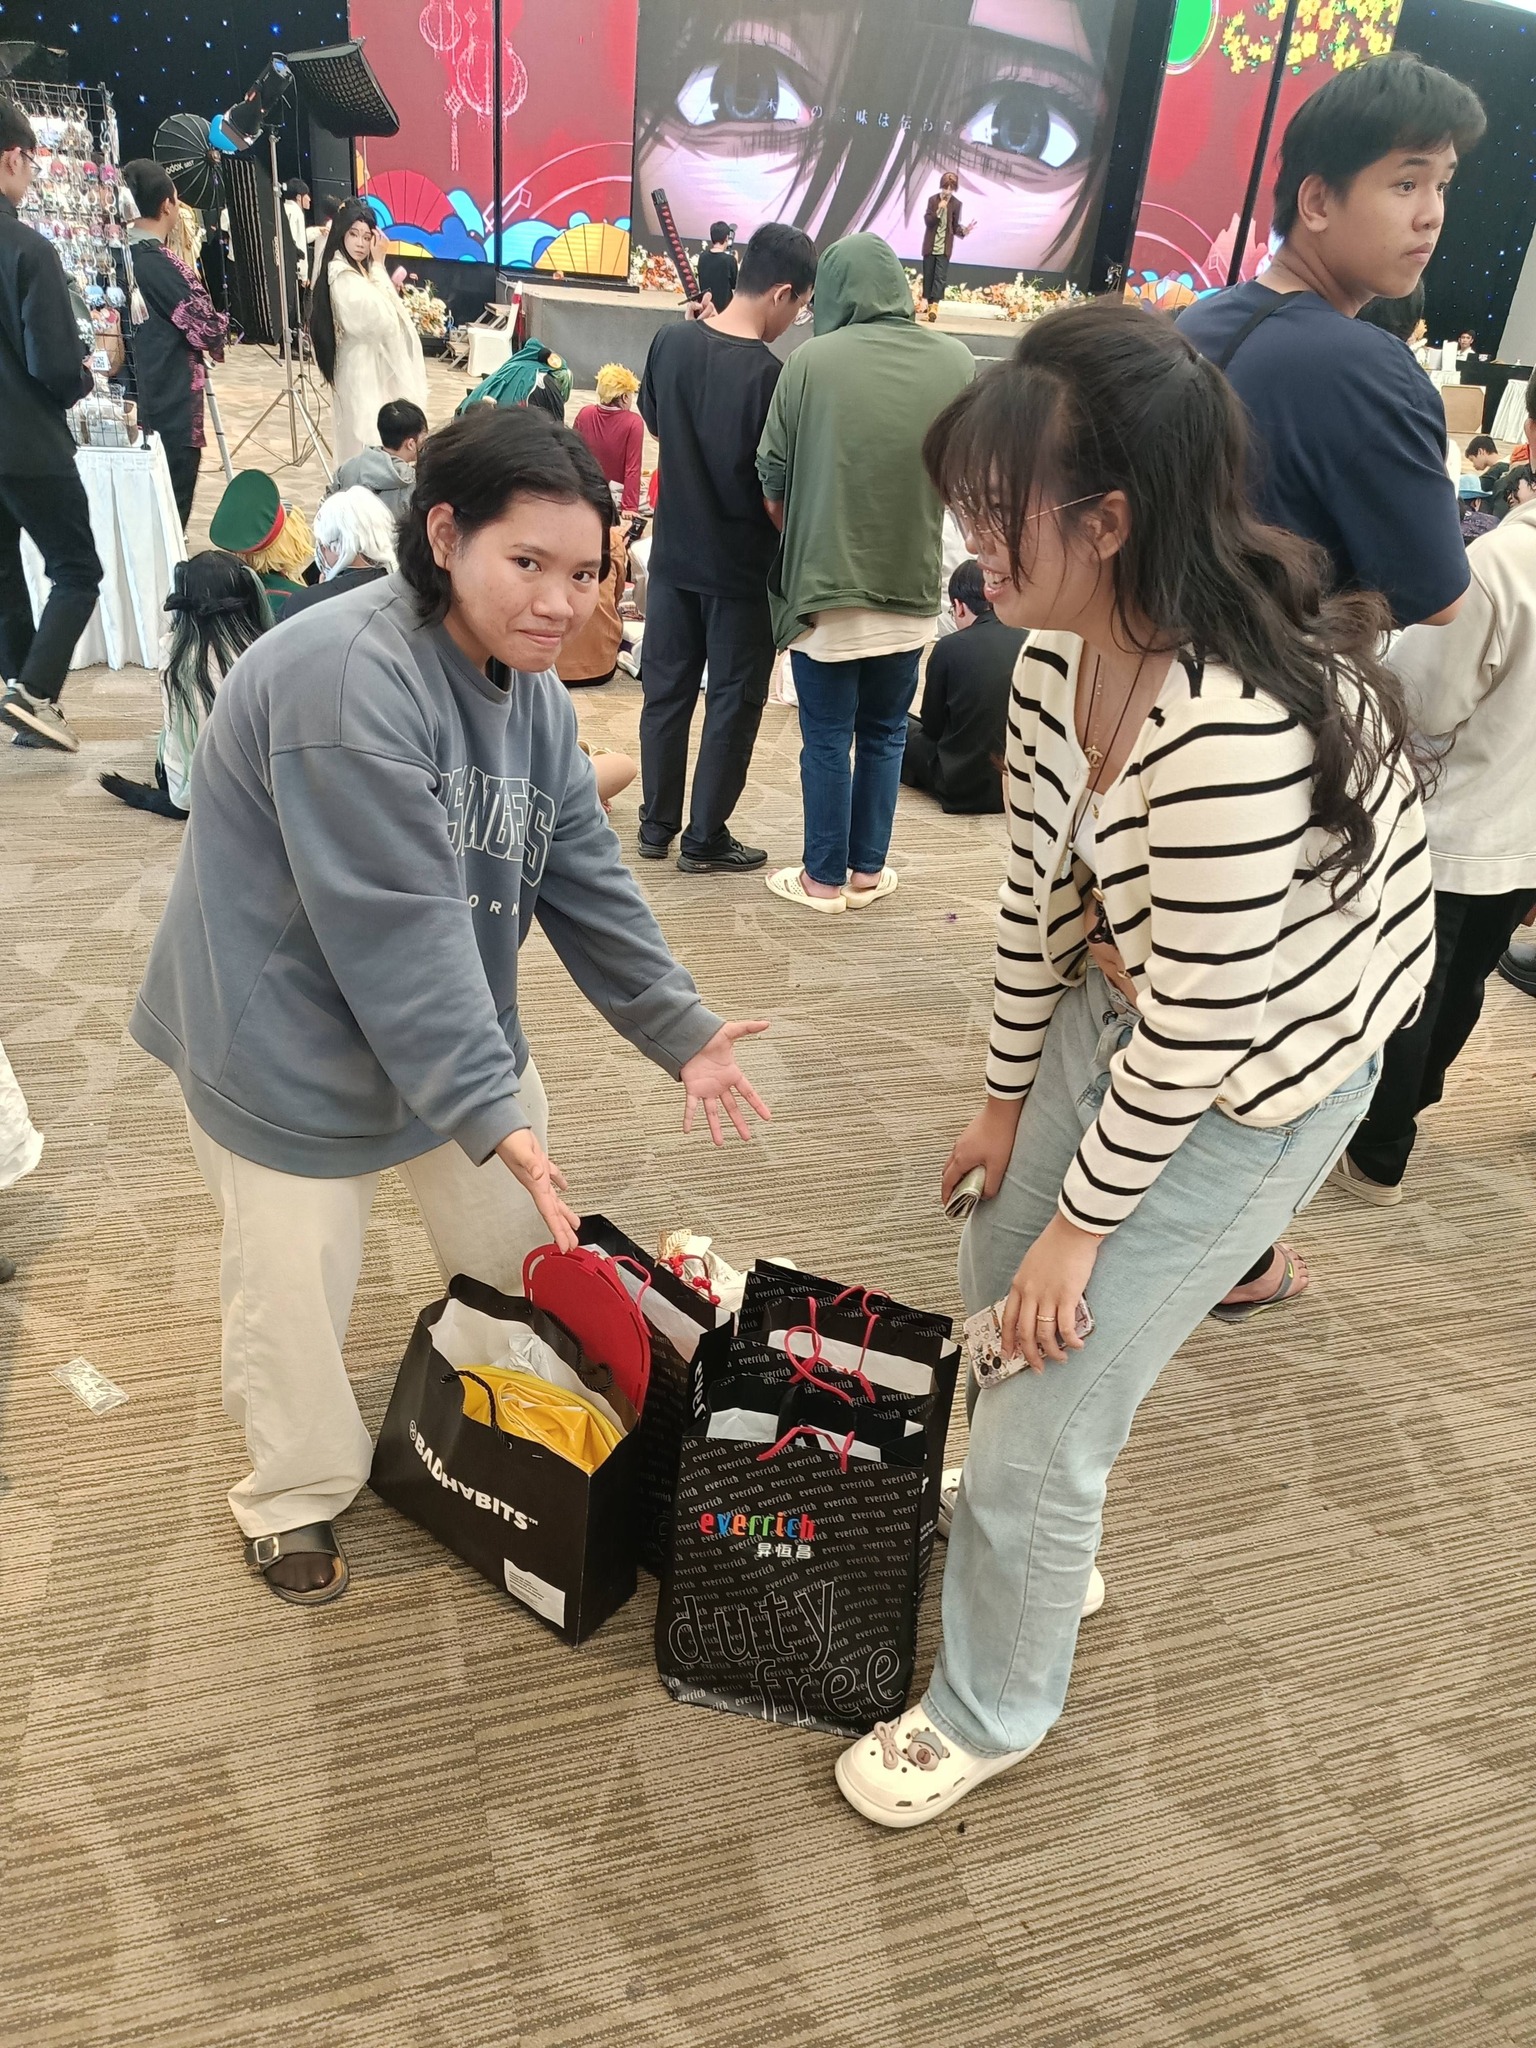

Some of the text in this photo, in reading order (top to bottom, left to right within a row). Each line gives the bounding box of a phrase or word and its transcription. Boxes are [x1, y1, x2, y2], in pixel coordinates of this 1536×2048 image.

[165, 162, 184, 175] odox
[738, 1353, 770, 1366] everrich
[692, 1446, 728, 1463] everrich
[680, 1466, 711, 1485] verrich
[717, 1456, 752, 1472] everrich
[704, 1475, 740, 1492] everrich
[745, 1464, 781, 1480] everrich
[787, 1454, 822, 1470] everrich
[688, 1461, 889, 1515] everrich everrich everrich everric everrich
[757, 1493, 793, 1509] everrich
[799, 1484, 834, 1498] everrich
[840, 1479, 875, 1491] everrich
[882, 1471, 918, 1486] everrich
[823, 1496, 858, 1509] everrich
[864, 1492, 900, 1504] everrich
[689, 1547, 723, 1560] everrich
[729, 1533, 764, 1553] everrich
[851, 1509, 886, 1521] everrich
[700, 1511, 815, 1540] everrich
[674, 1564, 708, 1577] everrich
[713, 1556, 748, 1571] everrich
[834, 1526, 870, 1539] everrich
[875, 1521, 911, 1534] everrich
[701, 1576, 735, 1587] everrich
[741, 1564, 776, 1581] everrich
[822, 1543, 856, 1555] everrich
[862, 1539, 898, 1551] everrich
[725, 1585, 759, 1598] everrich
[765, 1571, 800, 1591] everrich
[805, 1559, 840, 1576] everrich
[846, 1555, 881, 1566] everrich
[833, 1570, 868, 1583] everrich
[874, 1567, 908, 1577] everrich
[844, 1597, 879, 1612] everrich
[868, 1610, 901, 1621] everrich
[668, 1581, 834, 1671] duty
[855, 1624, 890, 1640] everrich
[840, 1644, 873, 1665] everrich
[750, 1647, 905, 1724] free
